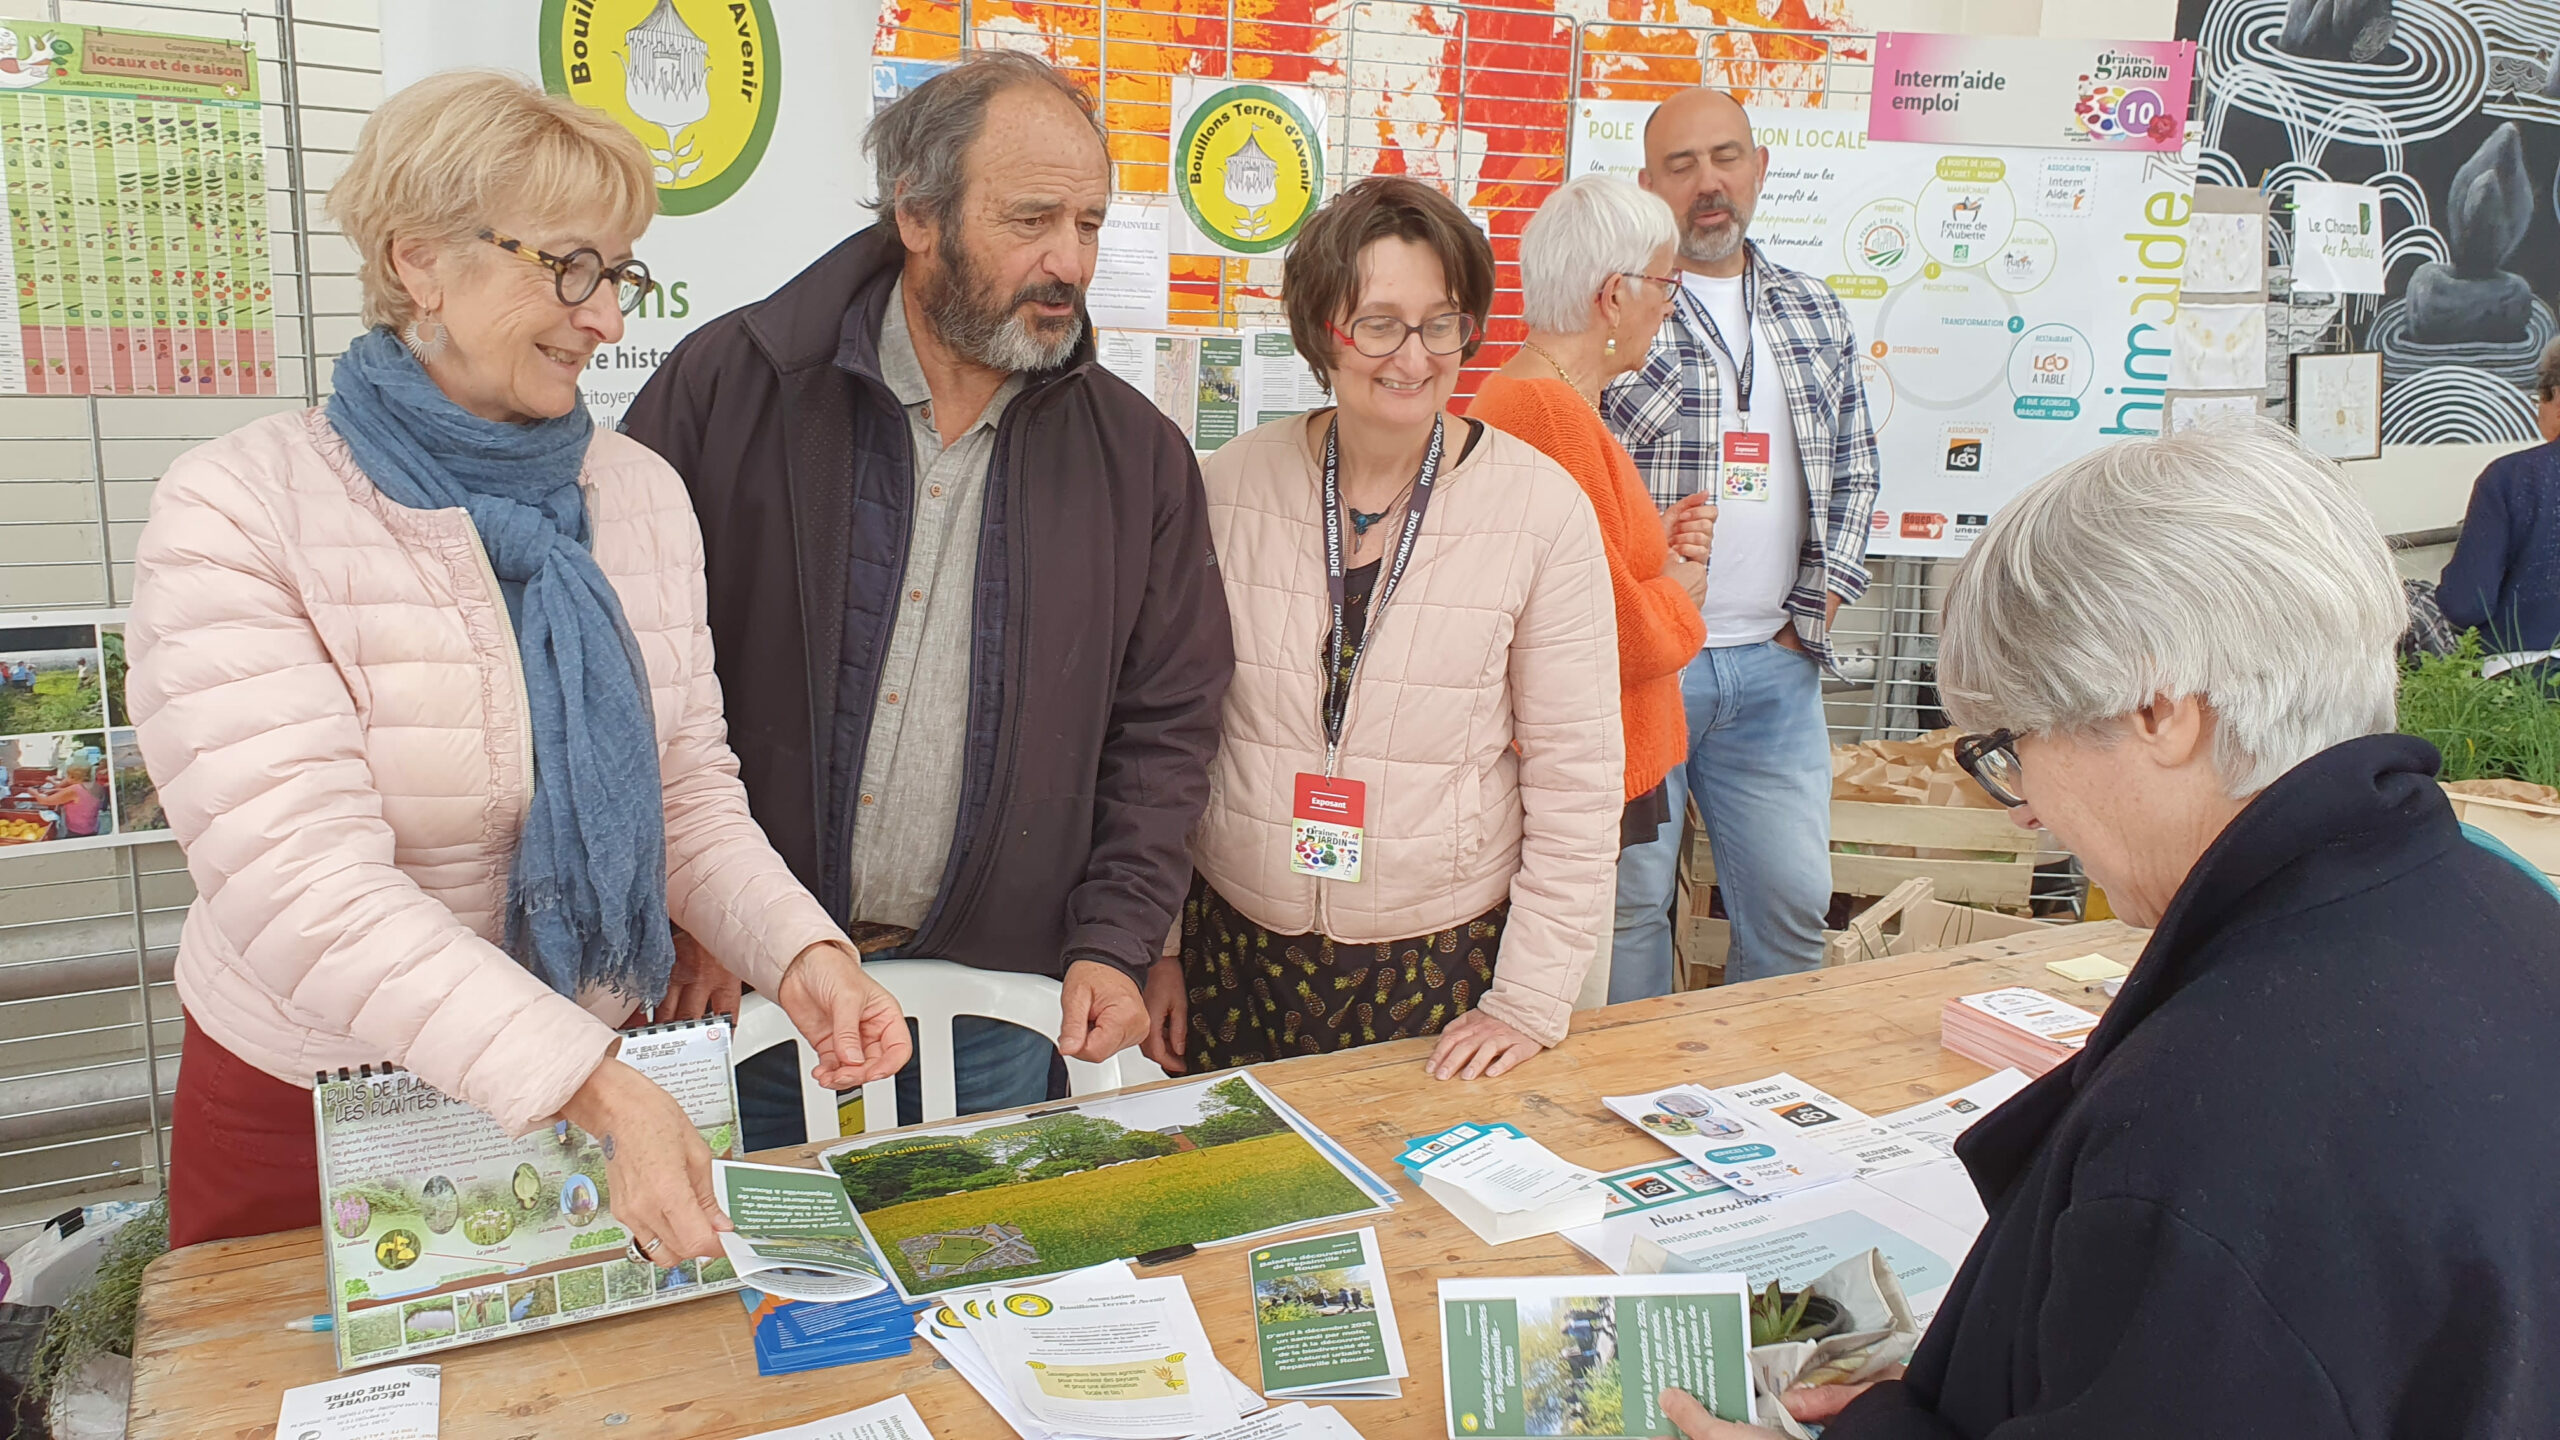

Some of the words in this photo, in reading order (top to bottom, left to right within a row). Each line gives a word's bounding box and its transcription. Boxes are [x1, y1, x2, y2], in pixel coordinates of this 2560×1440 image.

[570, 0, 597, 85] Bouil
[92, 52, 146, 70] locaux
[150, 59, 168, 71] et
[171, 61, 190, 73] de
[193, 63, 243, 78] saison
[2115, 65, 2168, 80] JARDIN
[1892, 93, 1960, 115] emploi
[2126, 101, 2155, 125] 10
[1189, 111, 1232, 185] Bouillons
[1232, 102, 1283, 125] Terres
[1587, 120, 1635, 141] POLE
[1795, 127, 1868, 150] LOCALE
[1589, 160, 1606, 173] Un
[1765, 168, 1801, 187] présent
[1803, 171, 1819, 180] sur
[1821, 168, 1835, 181] les
[2047, 163, 2091, 173] ASSOCIATION
[1775, 190, 1805, 206] profit
[1807, 190, 1819, 202] de
[2045, 188, 2069, 200] Aide
[1107, 219, 1161, 231] REPAINVILLE
[1941, 220, 1972, 231] Ferme
[1974, 221, 1988, 231] de
[2308, 217, 2321, 233] Le
[2324, 217, 2359, 237] Champ
[1769, 233, 1823, 247] Normandie
[2040, 374, 2066, 386] TABLE
[1419, 423, 1443, 487] métropole
[1326, 509, 1341, 578] NORMANDIE
[1393, 509, 1421, 578] NORMANDIE
[1311, 797, 1347, 809] Exposant
[1317, 836, 1348, 847] JARDIN
[326, 1083, 368, 1107] PLUS
[371, 1080, 393, 1099] DE
[396, 1075, 434, 1095] PLA
[334, 1101, 370, 1126] LES
[370, 1092, 438, 1118] PLANTES
[1648, 1210, 1697, 1229] Nous
[1656, 1230, 1706, 1247] missions
[1706, 1225, 1729, 1238] de
[1729, 1214, 1769, 1232] travail
[1259, 1254, 1298, 1268] Balades
[1299, 1247, 1358, 1262] découvertes
[1287, 1256, 1340, 1269] Repainville
[1294, 1263, 1326, 1272] Rouen
[1290, 1333, 1323, 1343] samedi
[1304, 1322, 1349, 1335] décembre
[1663, 1306, 1677, 1367] découverte
[1689, 1320, 1701, 1357] urbain
[1271, 1343, 1300, 1353] partez
[1320, 1334, 1371, 1346] découverte
[1301, 1342, 1356, 1355] biodiversité
[1478, 1303, 1492, 1379] découvertes
[1274, 1357, 1296, 1367] parc
[1297, 1352, 1330, 1363] naturel
[1331, 1348, 1361, 1359] urbain
[1279, 1359, 1331, 1372] Repainville
[1504, 1345, 1516, 1387] Rouen
[1639, 1328, 1652, 1383] décembre
[1676, 1324, 1692, 1391] biodiversité
[1692, 1356, 1705, 1397] naturel
[324, 1389, 365, 1404] OFFRE
[369, 1381, 411, 1394] NOTRE
[327, 1389, 406, 1410] DÉCOUVREZ
[1482, 1379, 1496, 1430] Balades
